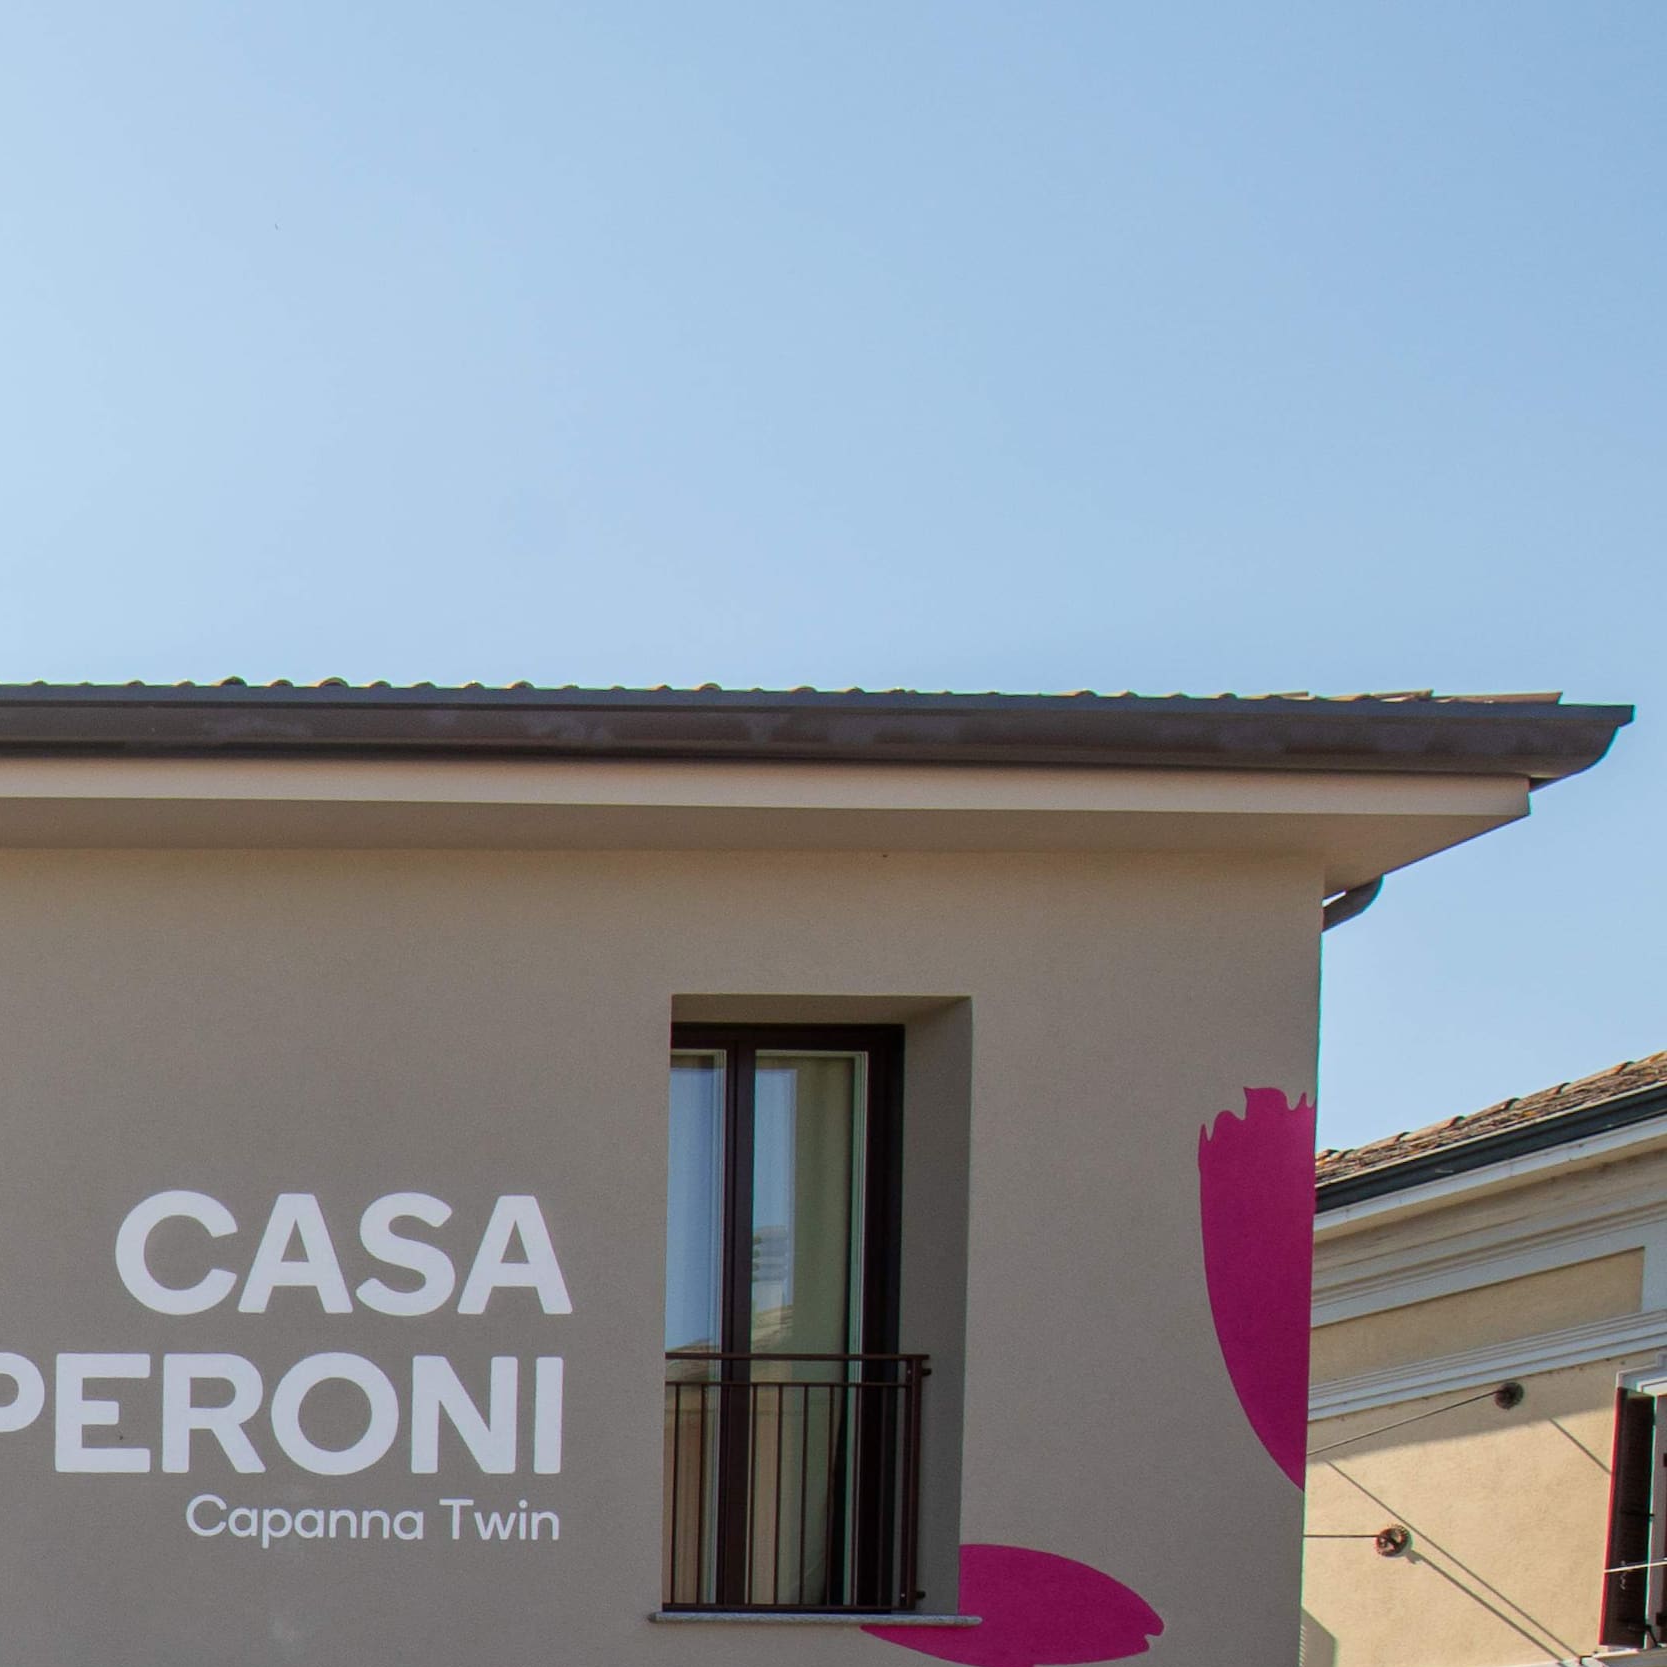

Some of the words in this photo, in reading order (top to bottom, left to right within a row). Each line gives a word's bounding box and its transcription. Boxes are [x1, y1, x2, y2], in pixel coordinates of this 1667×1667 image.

[115, 1190, 573, 1317] CASA
[185, 1494, 424, 1548] Capanna
[439, 1498, 561, 1541] Twin
